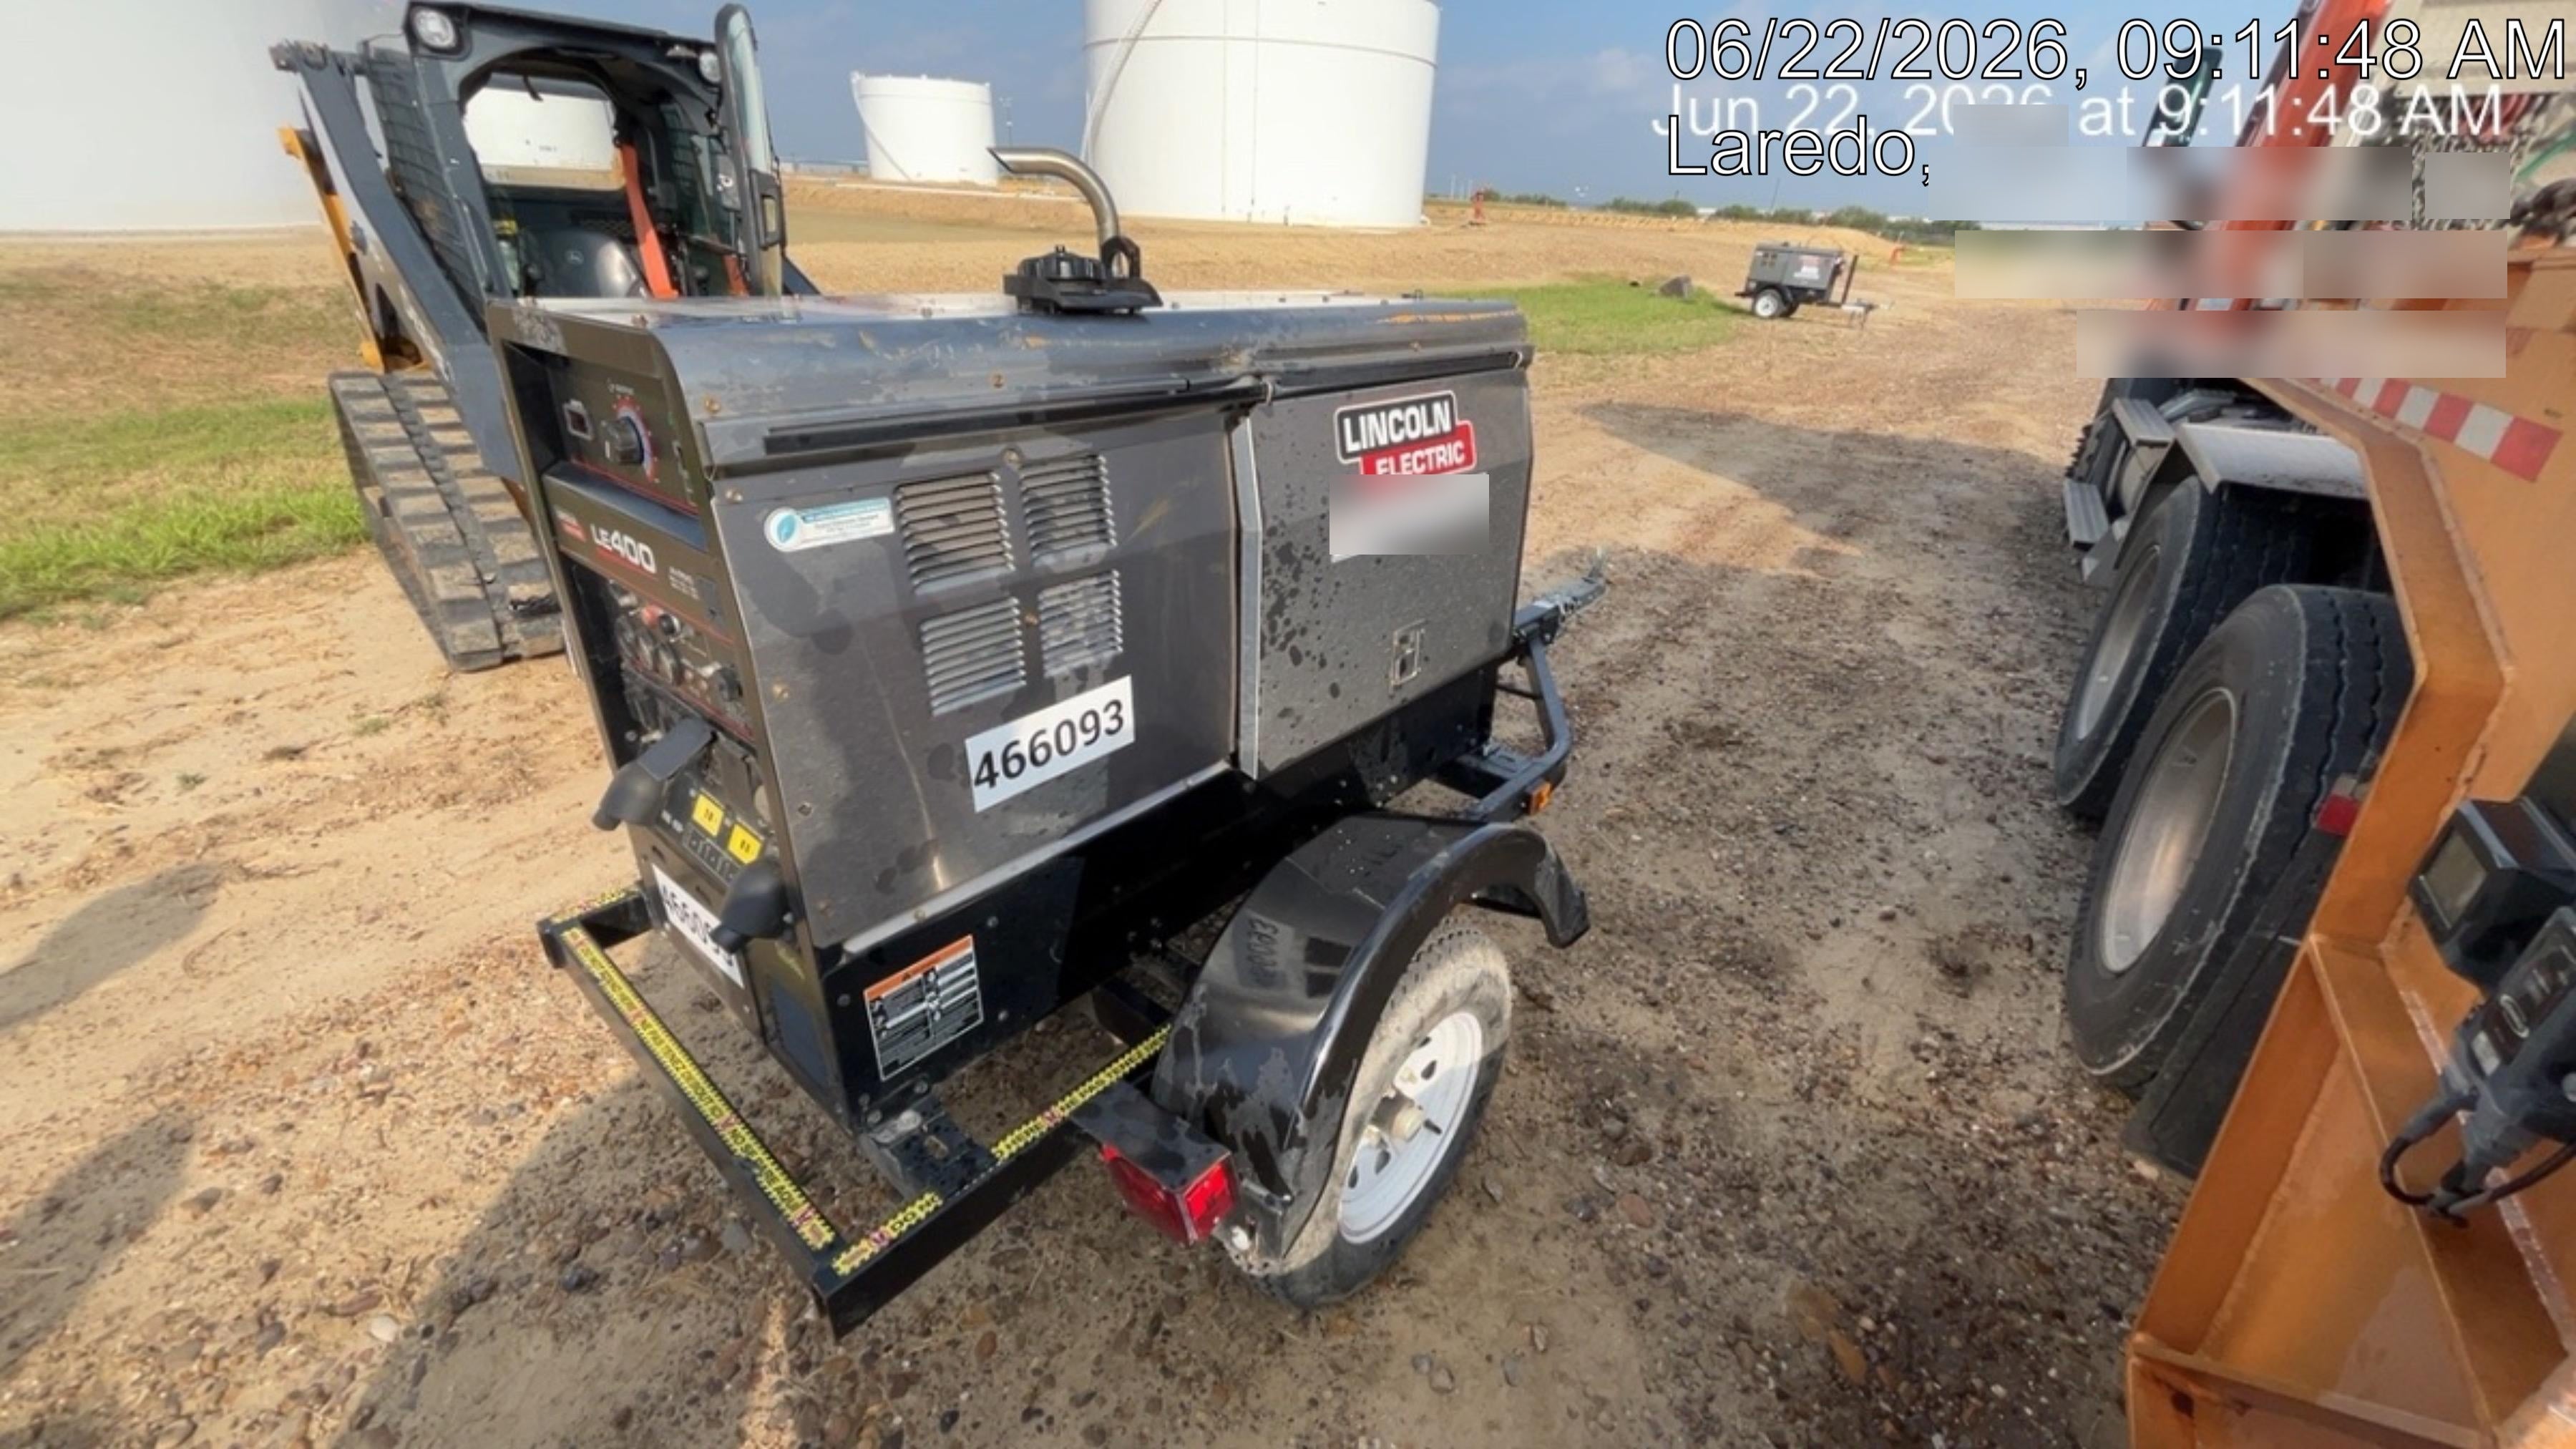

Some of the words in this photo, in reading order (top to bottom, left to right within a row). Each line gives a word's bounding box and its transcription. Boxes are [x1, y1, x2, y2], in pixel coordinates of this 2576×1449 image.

[1343, 400, 1451, 453] LINCOLN
[1375, 441, 1465, 474] ELECTRIC
[590, 524, 657, 574] LE400
[974, 699, 1123, 788] 466093
